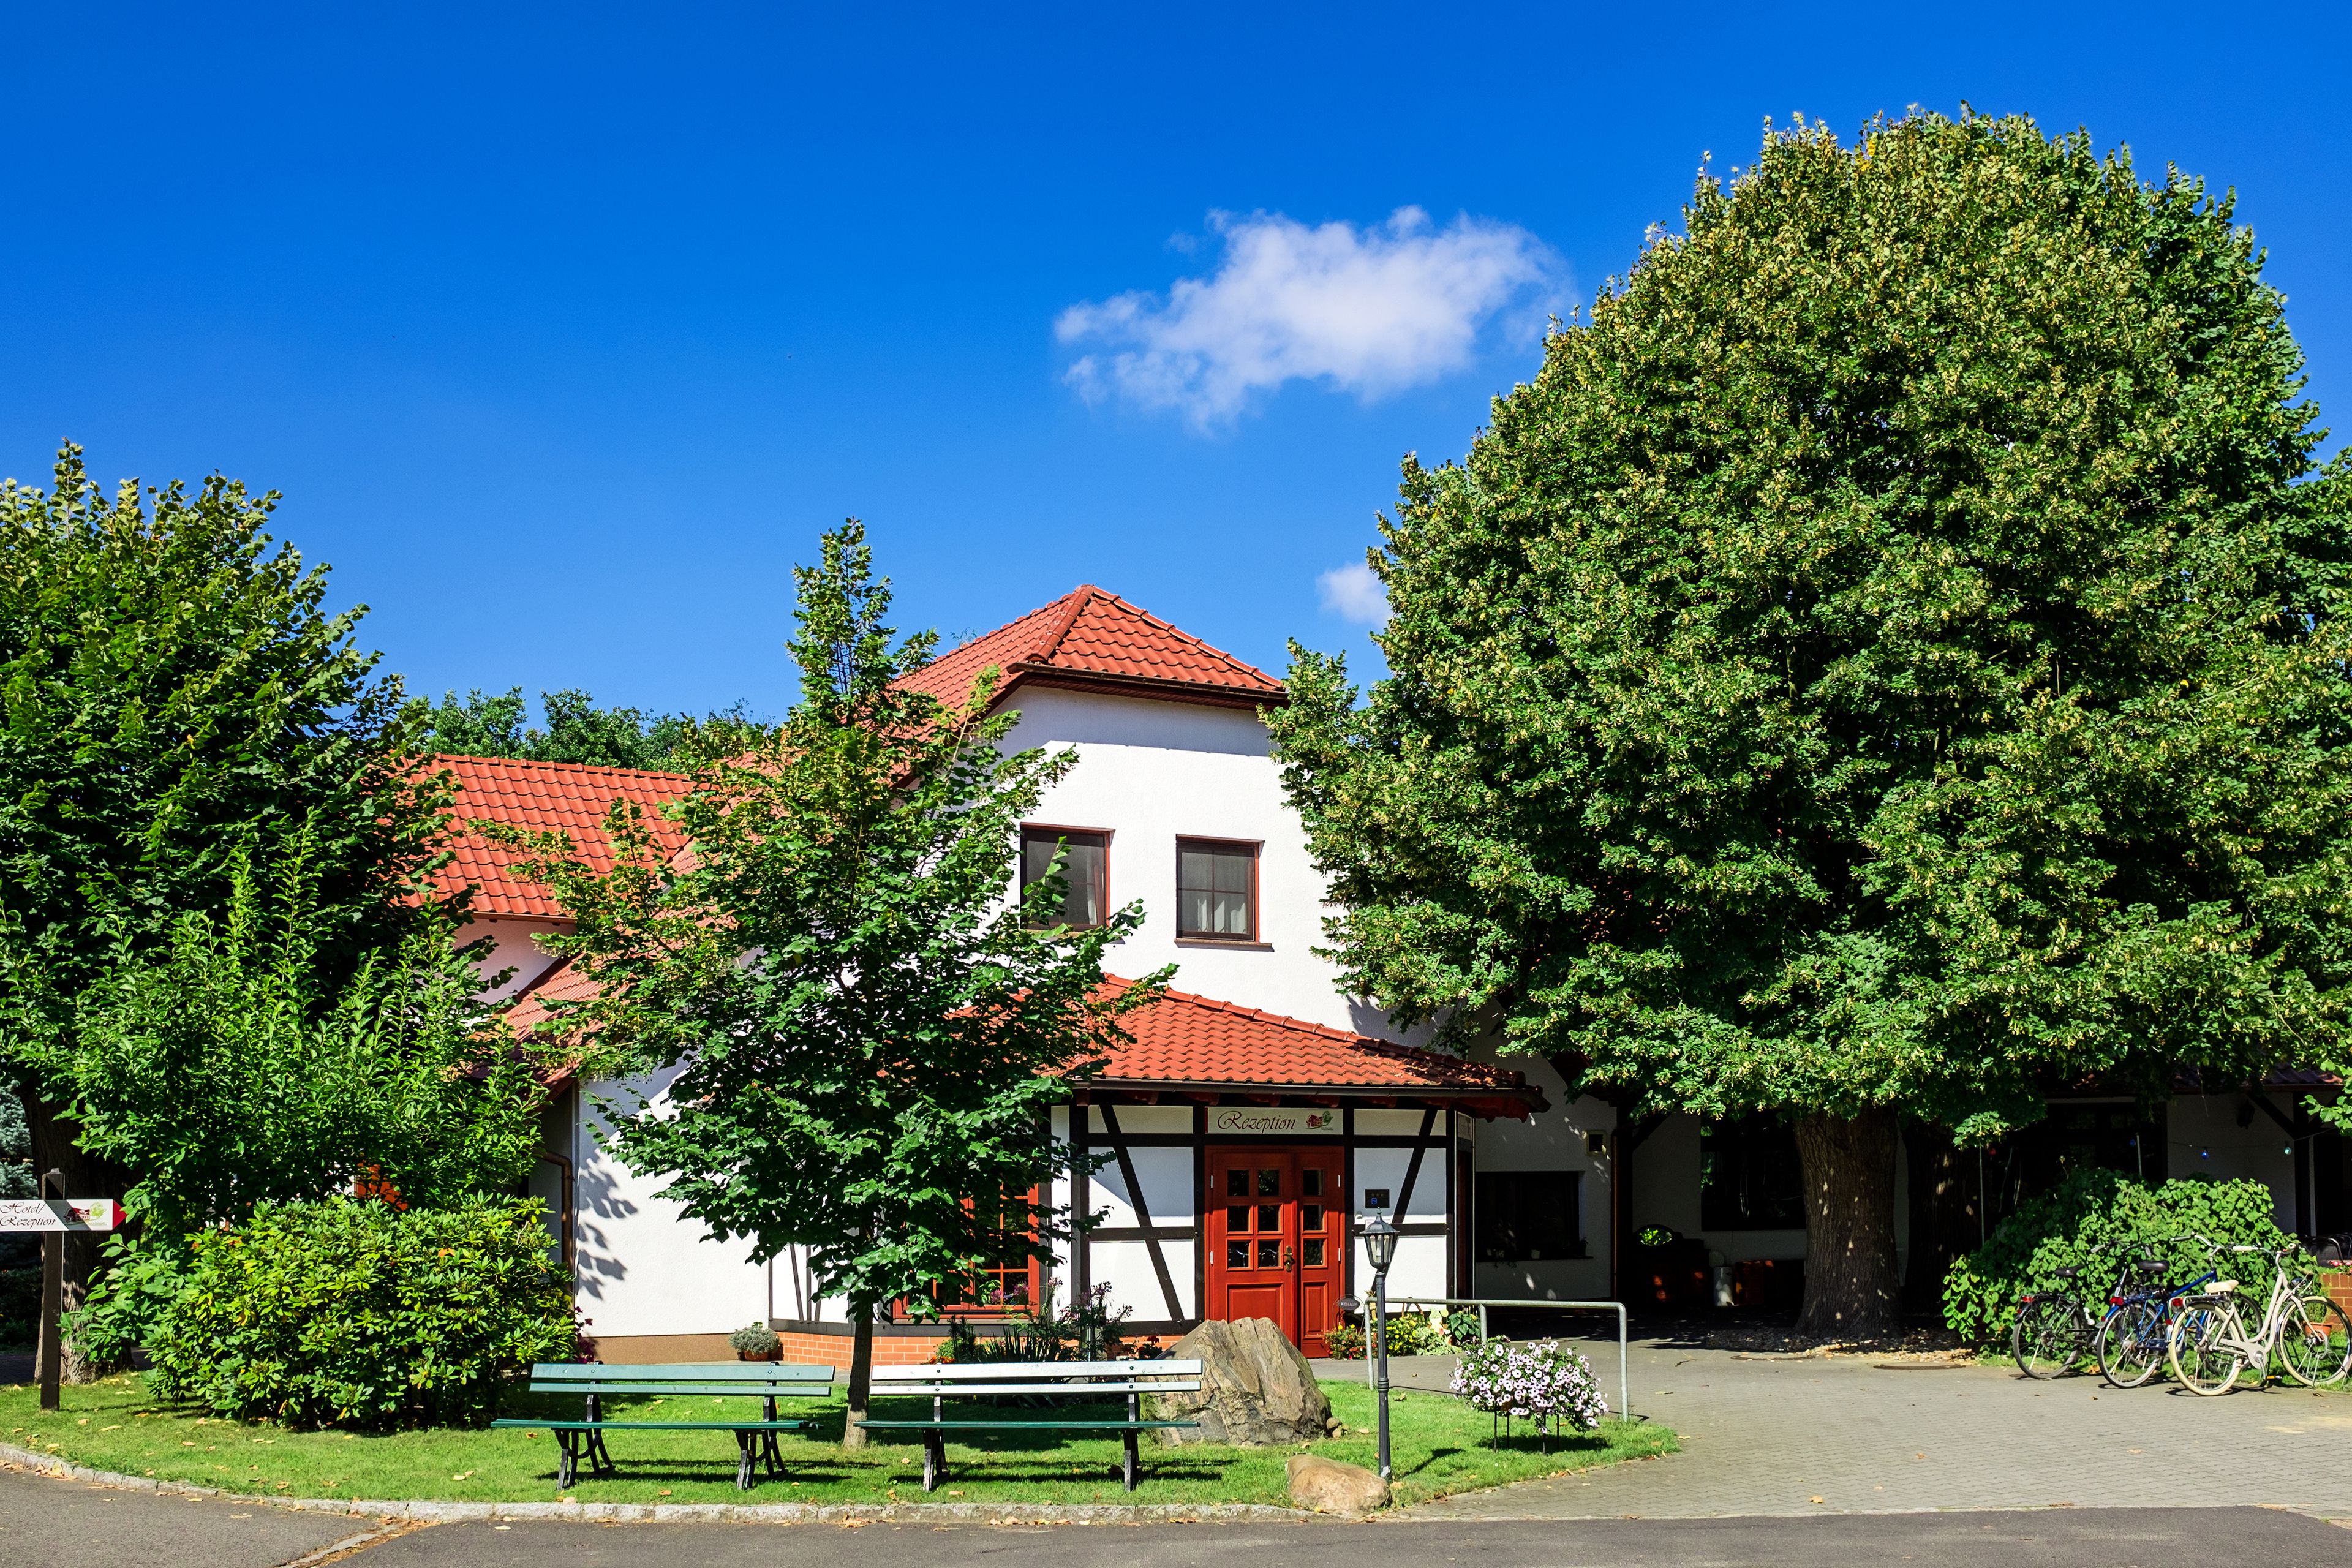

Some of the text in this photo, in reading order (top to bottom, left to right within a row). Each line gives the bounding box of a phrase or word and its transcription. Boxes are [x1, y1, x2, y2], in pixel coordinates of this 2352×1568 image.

[1218, 1110, 1296, 1133] Rezeption
[0, 1202, 47, 1214] Hotel/
[0, 1215, 56, 1229] Rezeption
